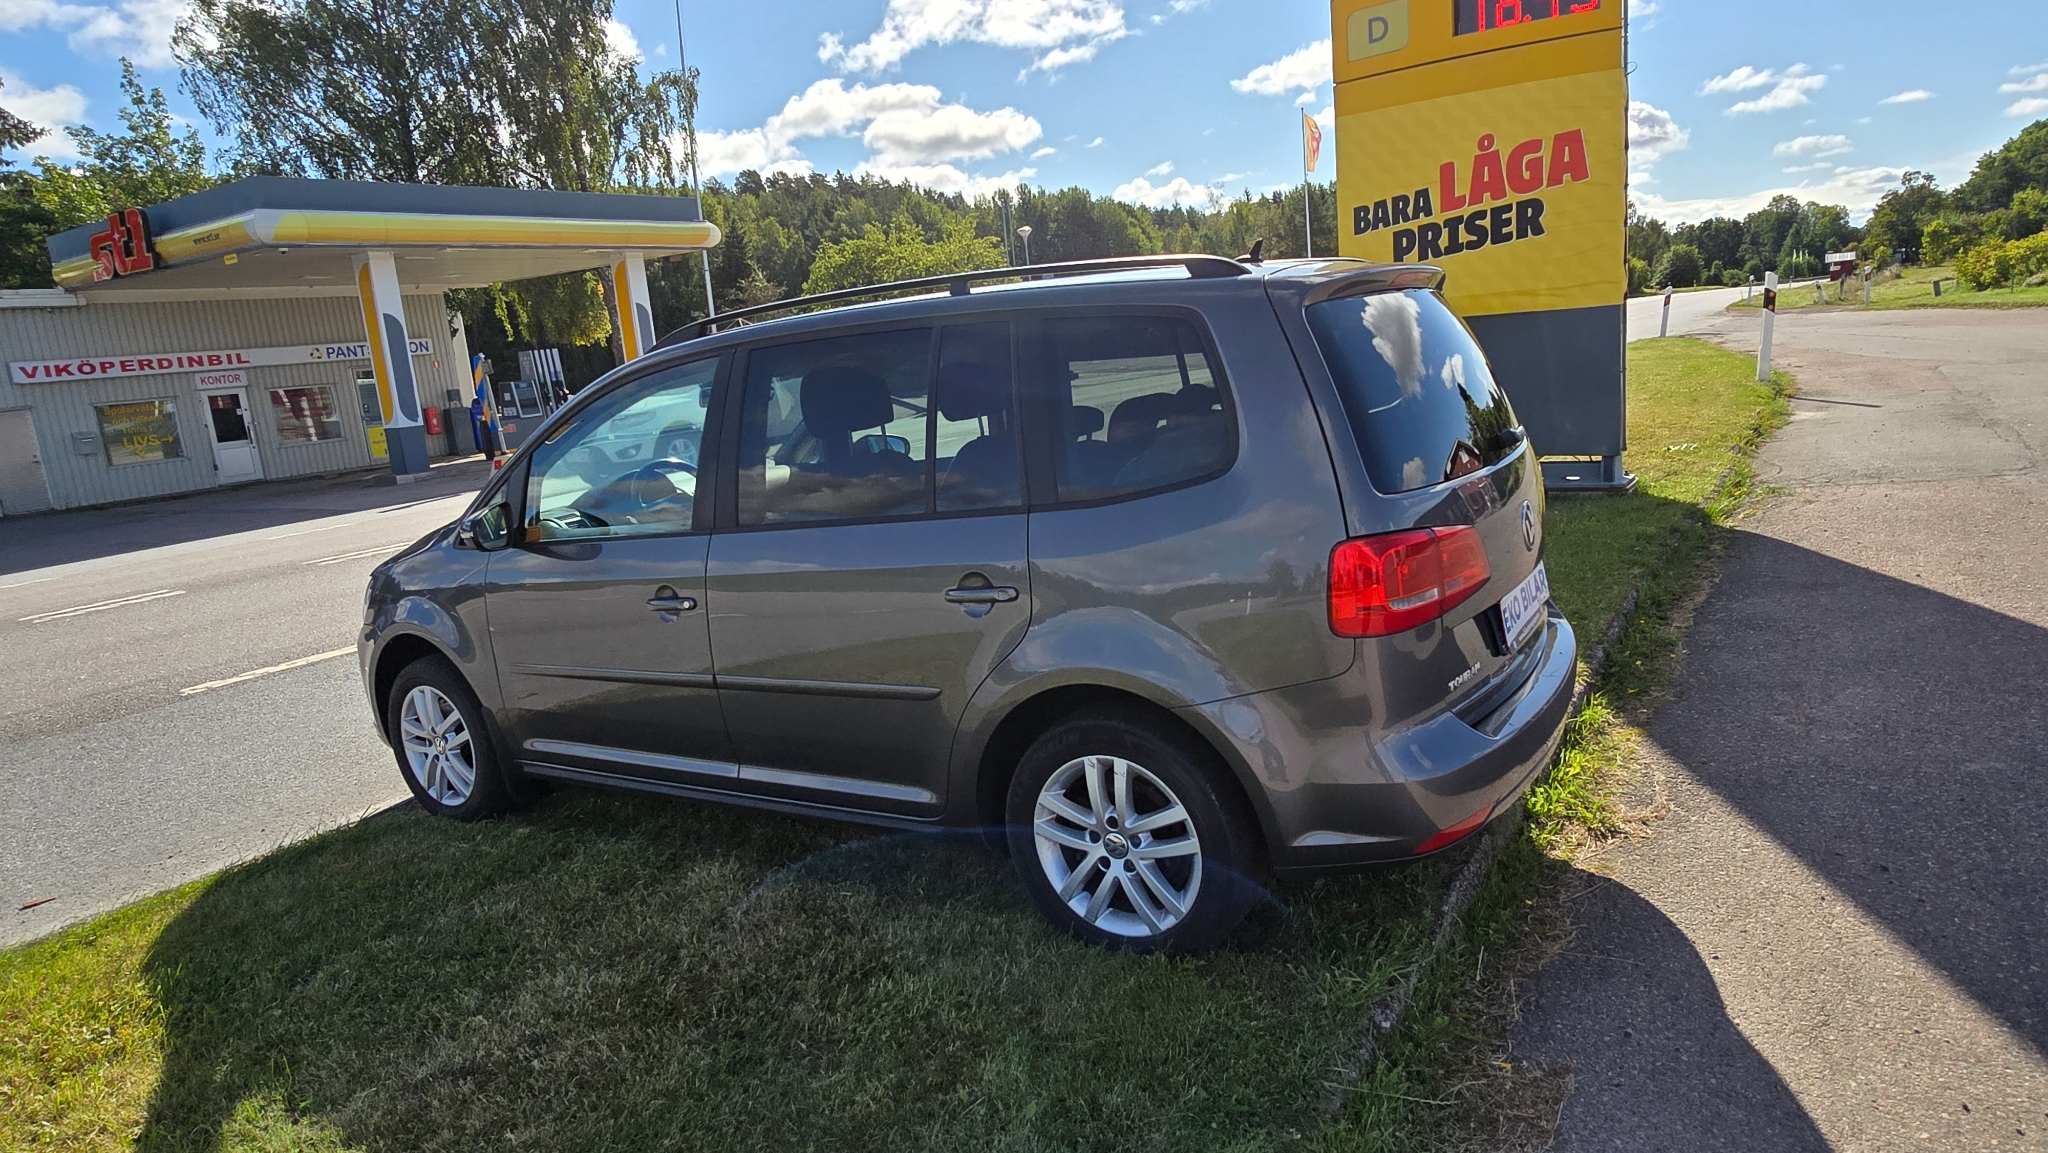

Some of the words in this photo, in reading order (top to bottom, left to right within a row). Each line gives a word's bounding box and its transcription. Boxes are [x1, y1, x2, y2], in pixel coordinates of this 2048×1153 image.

[1367, 16, 1390, 45] D
[1478, 0, 1599, 32] 18.
[1353, 187, 1433, 236] BARA
[1440, 128, 1590, 214] LÅGA
[1392, 197, 1547, 264] PRISER
[18, 353, 250, 379] VIKÖPERDINBIL
[200, 374, 243, 386] KONTOR
[1502, 595, 1521, 635] EKO
[1520, 568, 1547, 613] BILAR
